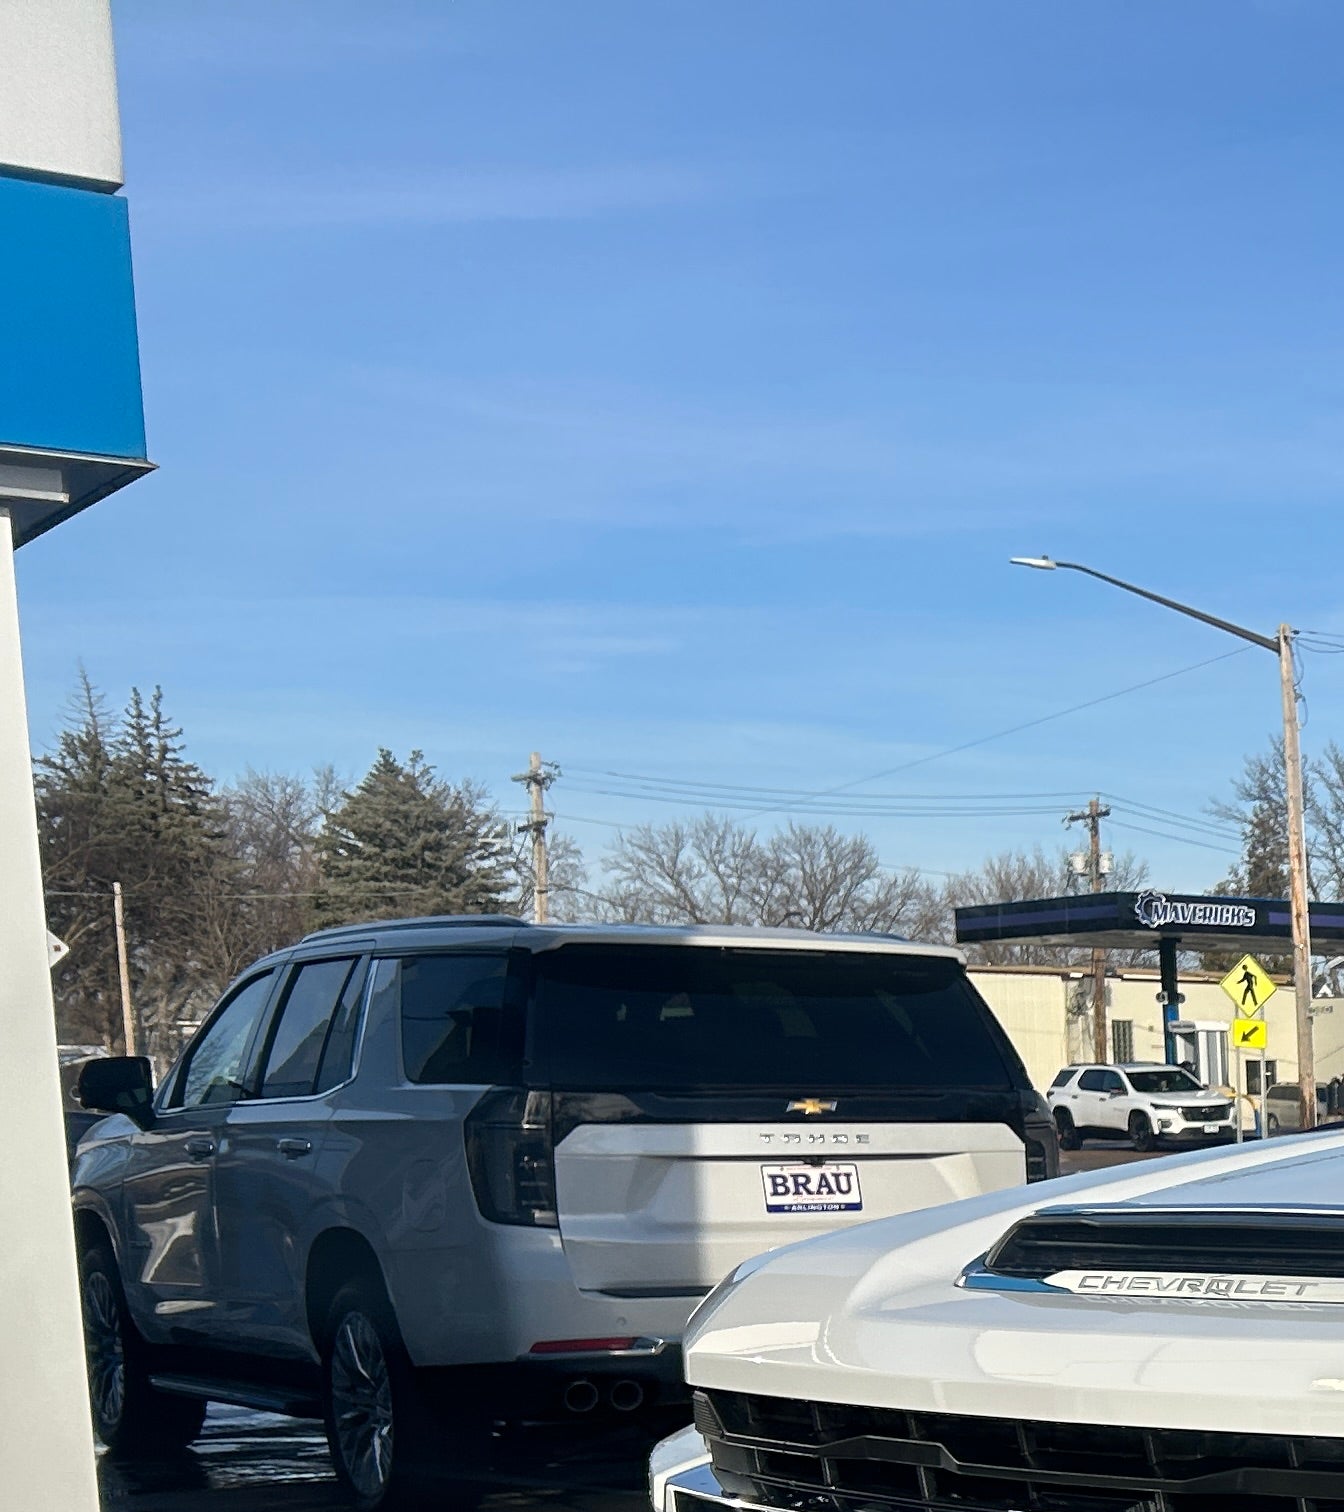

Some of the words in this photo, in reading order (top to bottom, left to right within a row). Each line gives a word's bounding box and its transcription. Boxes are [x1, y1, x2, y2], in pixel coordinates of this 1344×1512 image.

[759, 1132, 871, 1144] TAHOE
[767, 1172, 853, 1197] BRAU
[1077, 1274, 1319, 1297] CHEVROLET
